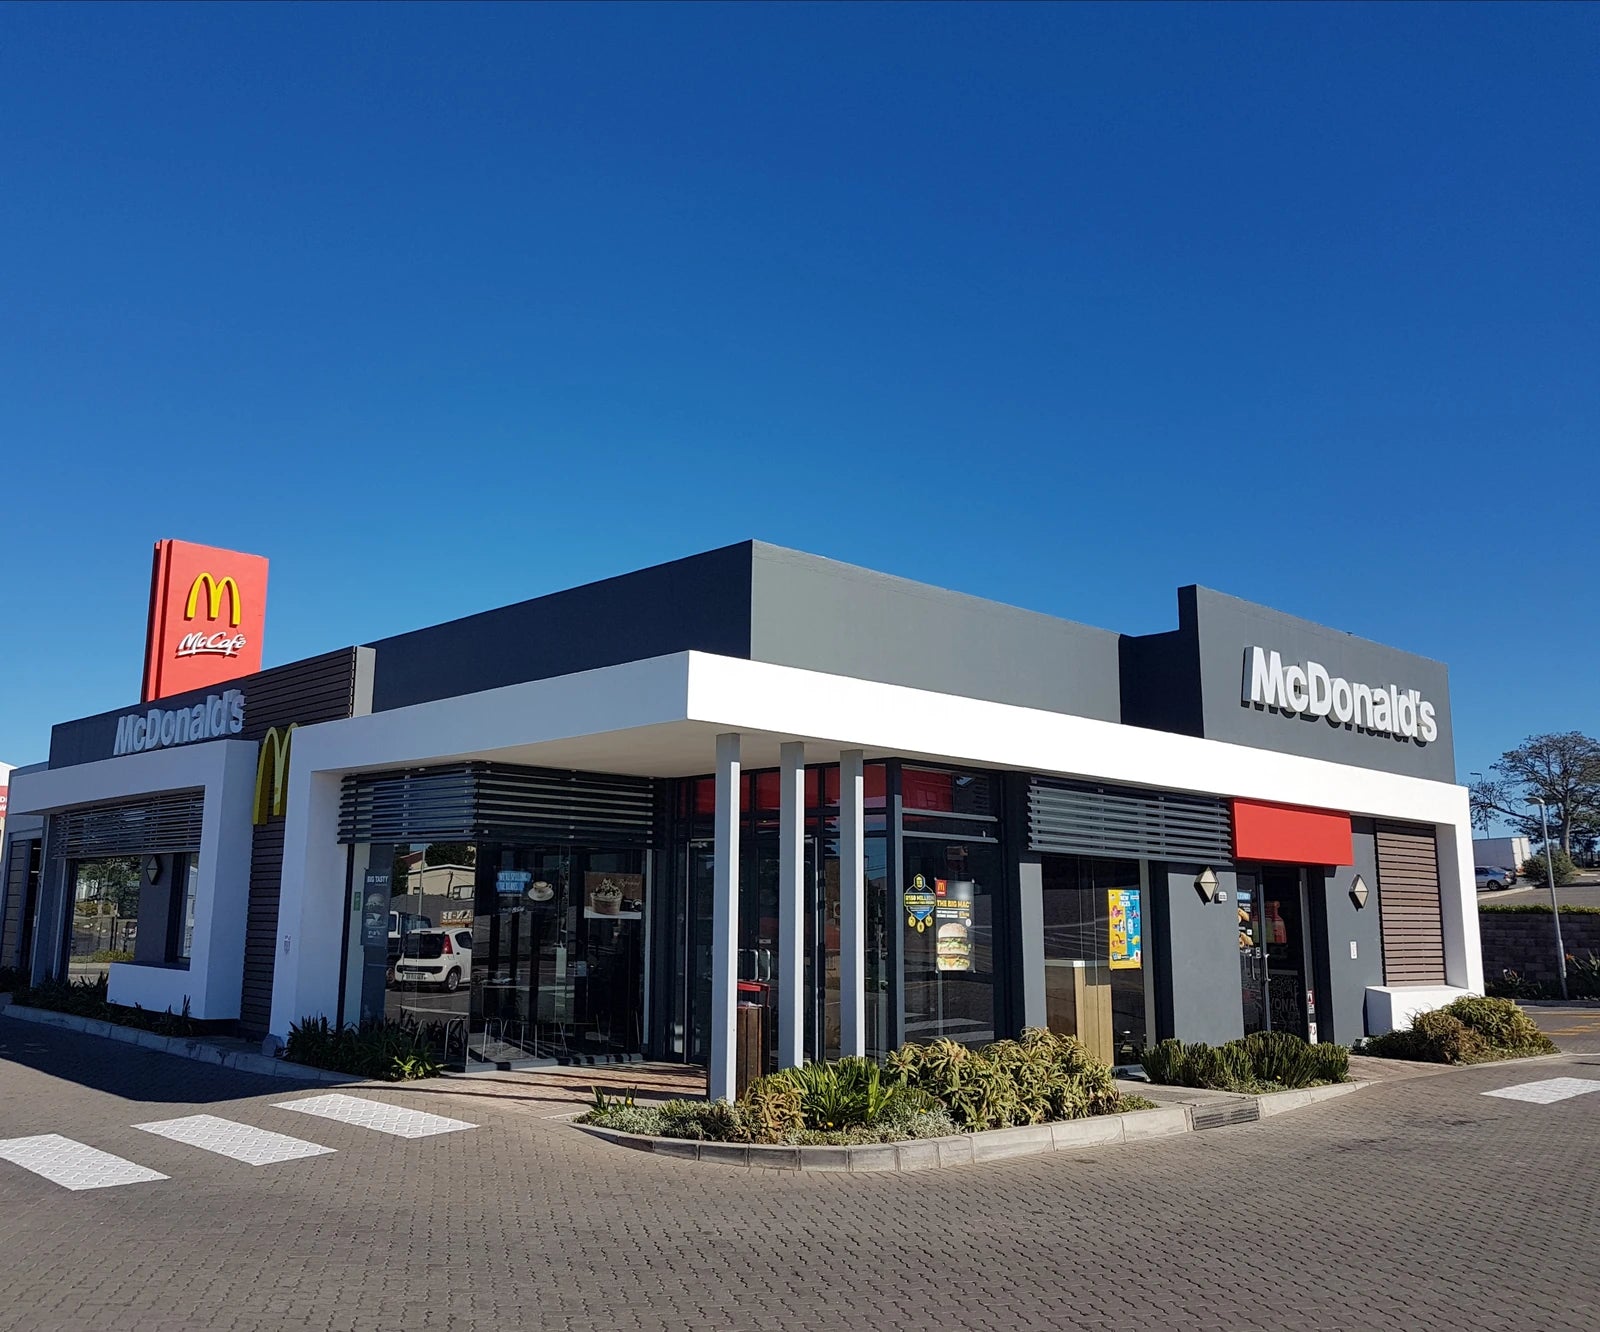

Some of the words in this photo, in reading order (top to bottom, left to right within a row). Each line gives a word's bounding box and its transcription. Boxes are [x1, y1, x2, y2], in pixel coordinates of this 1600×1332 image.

[178, 631, 247, 656] McCafé
[1243, 645, 1438, 742] McDonald's
[113, 689, 246, 756] McDonald's
[937, 899, 947, 907] THE
[947, 900, 957, 908] BIG
